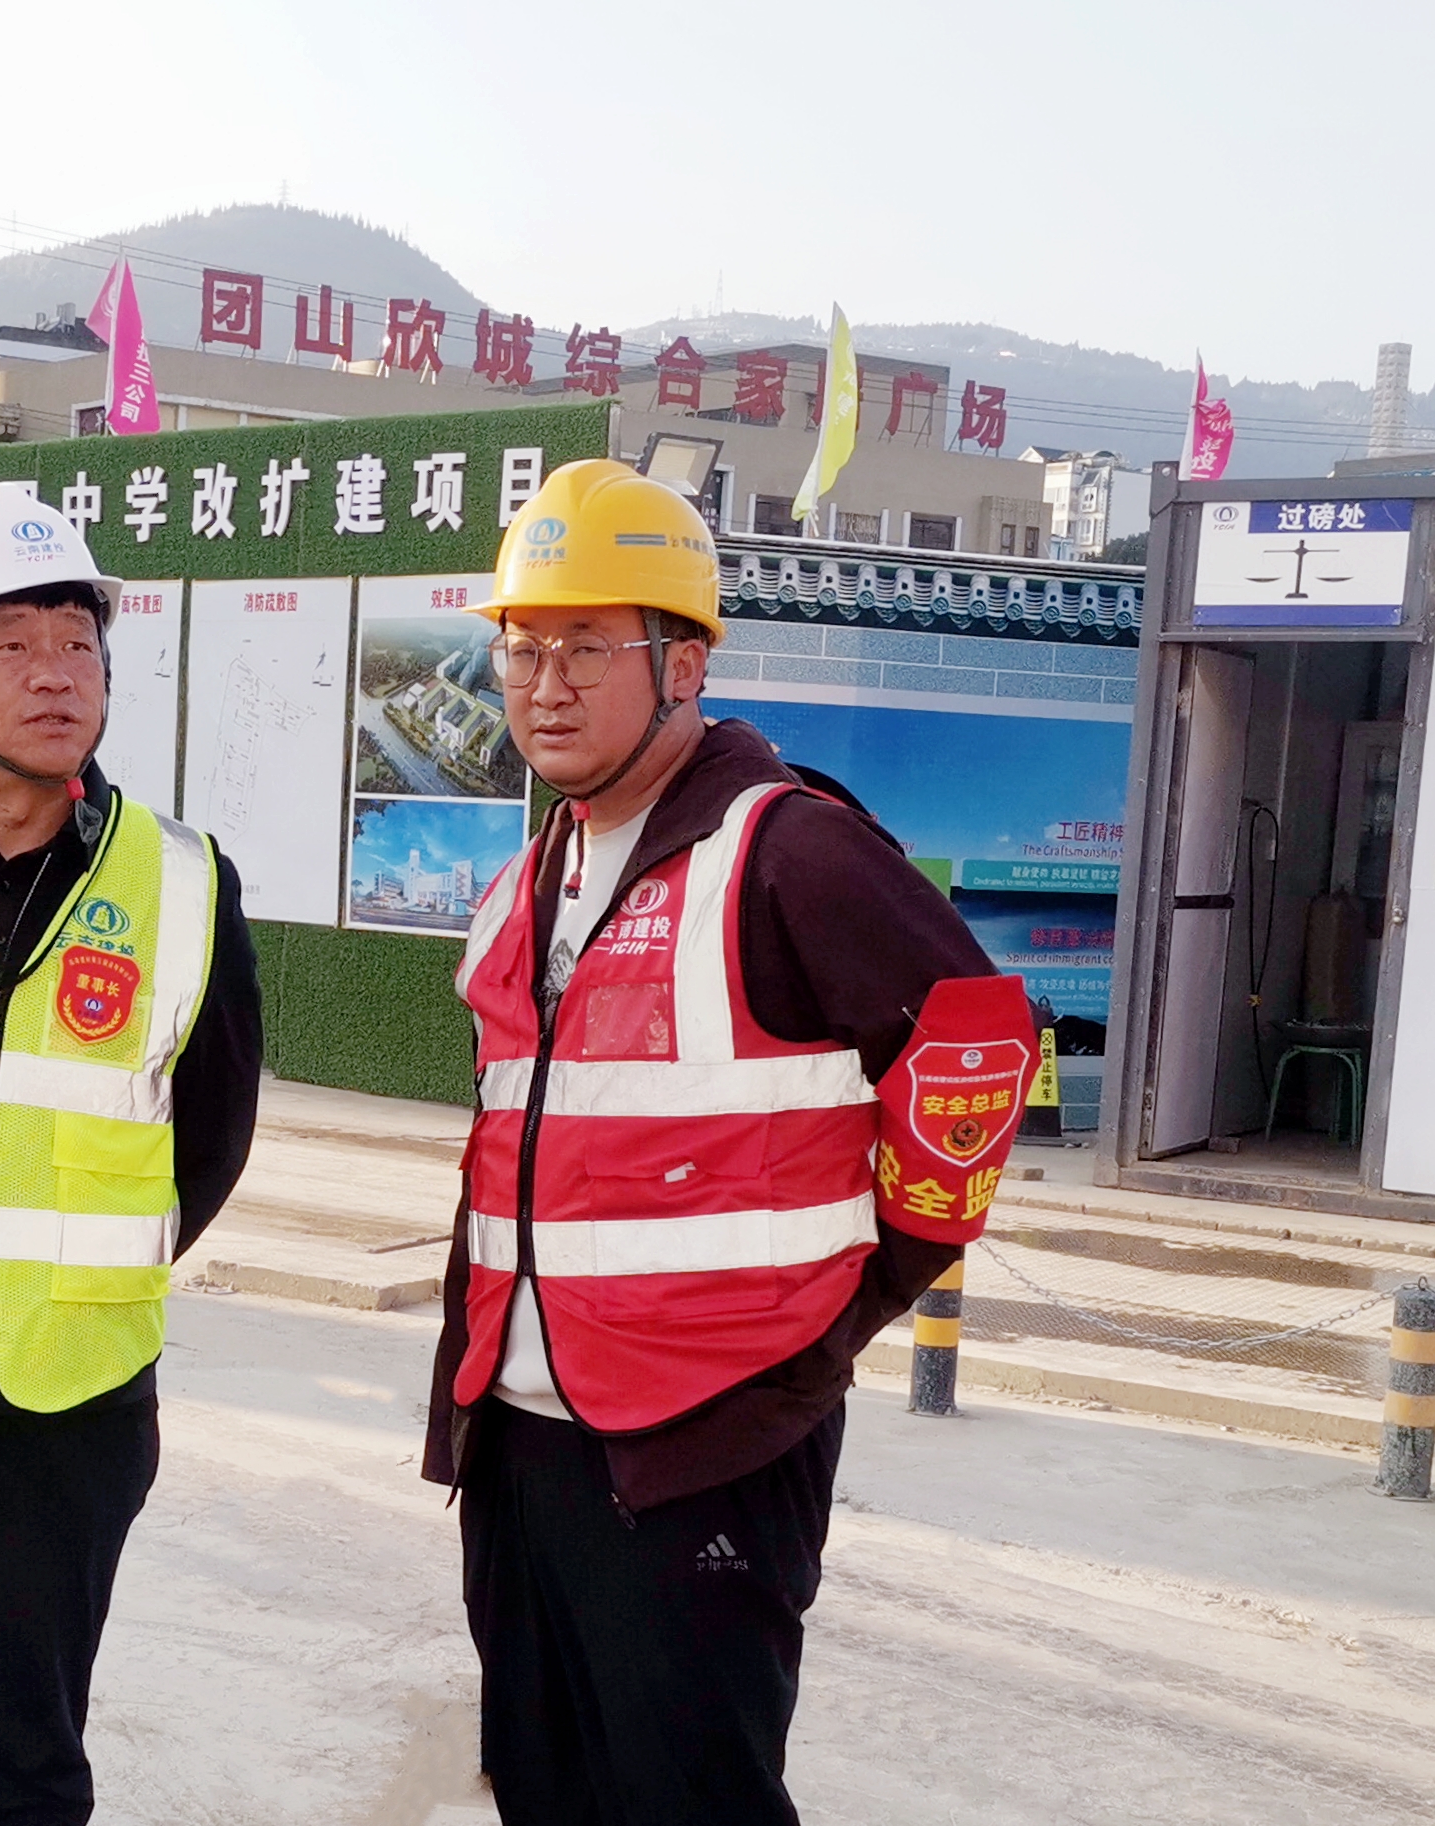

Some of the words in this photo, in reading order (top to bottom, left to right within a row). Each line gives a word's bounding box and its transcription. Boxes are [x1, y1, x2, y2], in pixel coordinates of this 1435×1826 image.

[202, 267, 1006, 448] 团山欣城综合家广场
[1278, 502, 1366, 531] 过磅处
[14, 542, 65, 556] 云南建投
[243, 592, 298, 613] 消防疏散图
[430, 587, 467, 609] 效果图
[1022, 843, 1042, 856] The
[1043, 844, 1118, 860] Craftsmanship
[598, 915, 671, 940] 云南建投
[609, 941, 649, 956] YCIH
[922, 1089, 1012, 1116] 安全总监
